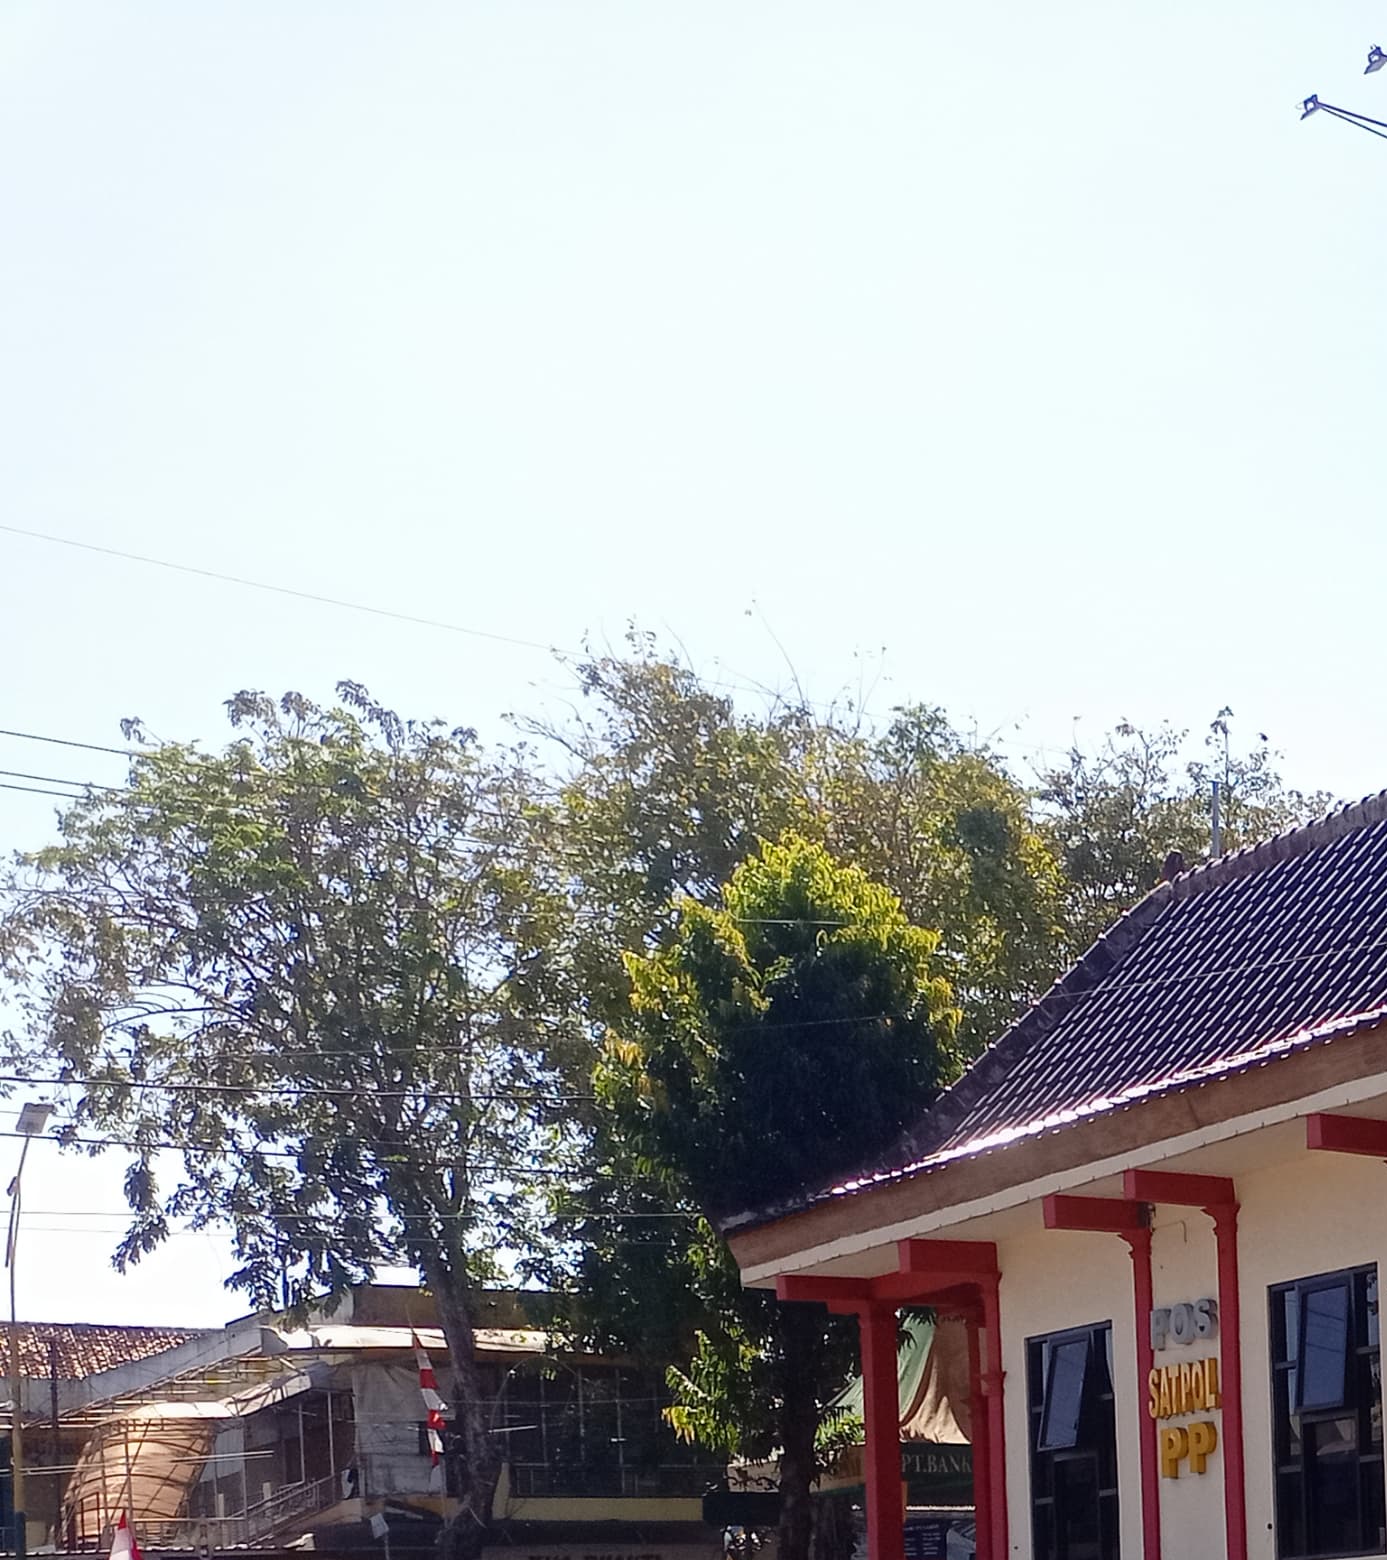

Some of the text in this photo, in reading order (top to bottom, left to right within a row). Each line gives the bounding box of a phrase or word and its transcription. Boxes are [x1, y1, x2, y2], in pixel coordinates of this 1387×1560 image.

[1150, 1298, 1218, 1351] POS
[1148, 1357, 1220, 1420] SATPOL
[1161, 1421, 1218, 1479] PP
